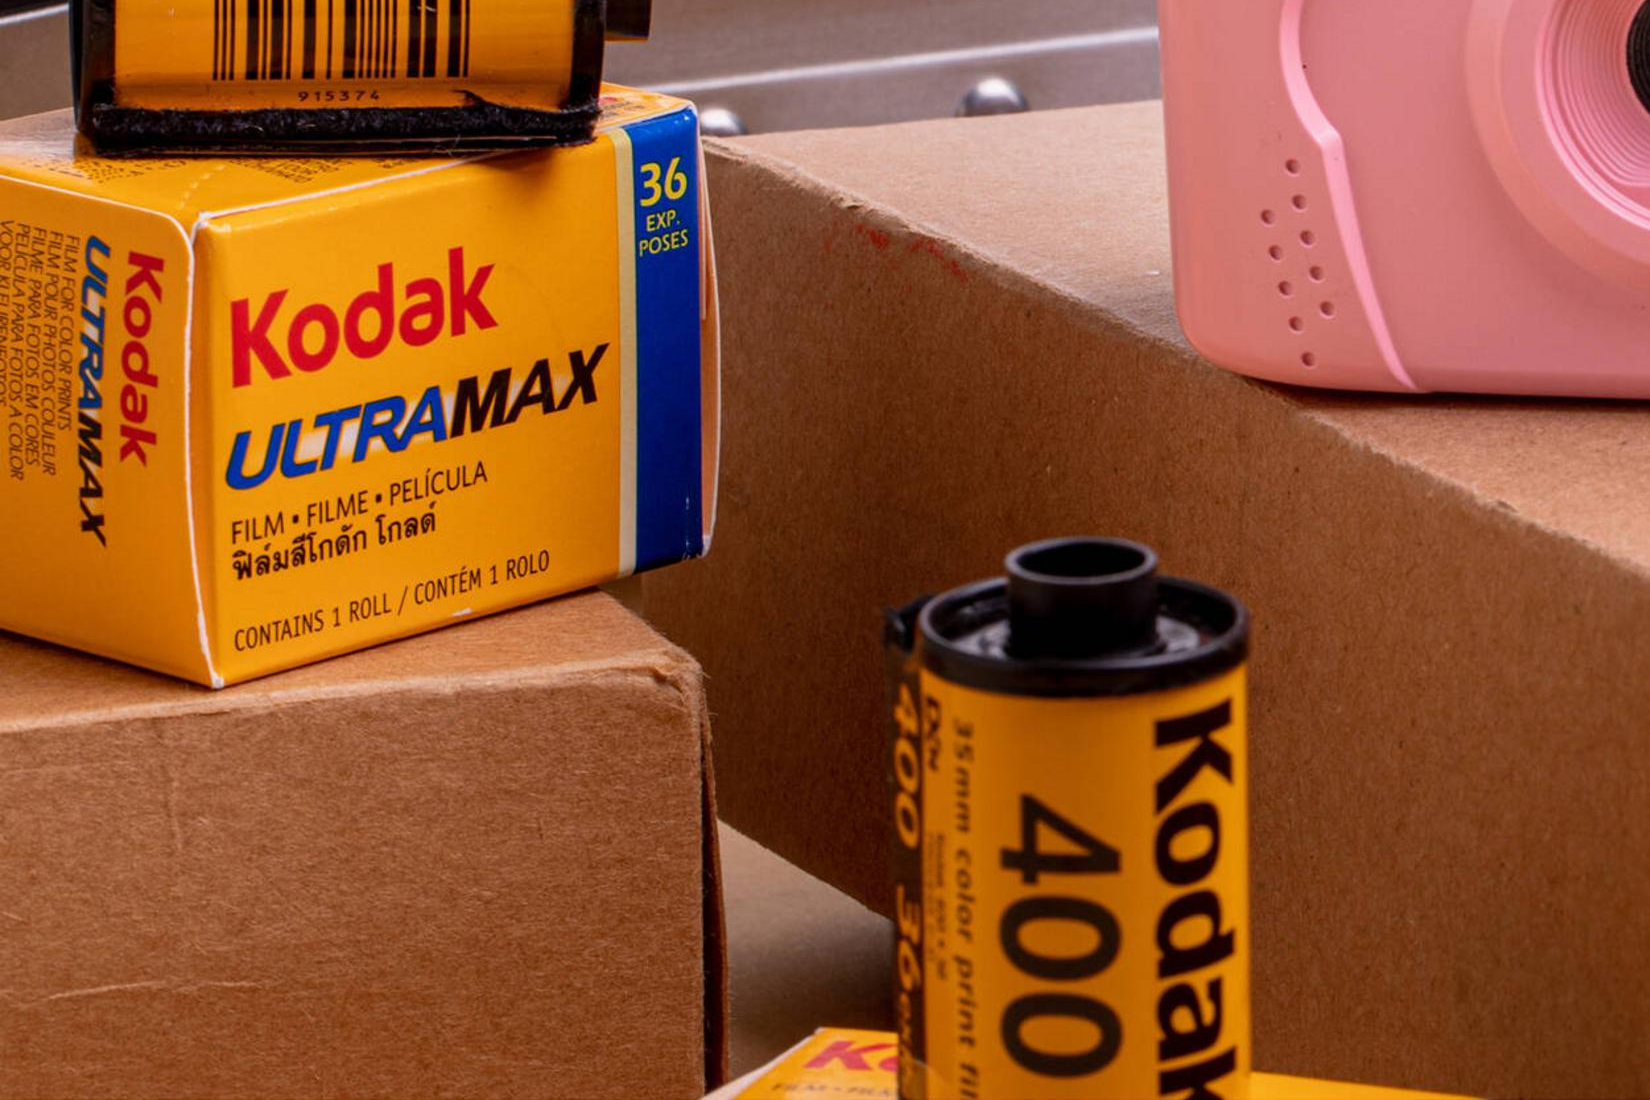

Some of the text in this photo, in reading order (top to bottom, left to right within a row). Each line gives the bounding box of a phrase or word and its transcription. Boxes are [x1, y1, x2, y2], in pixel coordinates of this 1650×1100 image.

[297, 90, 380, 102] 915374
[639, 228, 689, 258] POSES
[640, 156, 687, 207] 36
[646, 209, 681, 232] EXP.
[8, 223, 31, 481] PELÍCULA PARA FOTOS A COLOR
[25, 226, 47, 466] FILME PARA FOTOS EM CORES
[41, 230, 64, 476] FILM POUR PHOTOS COULEUR
[57, 234, 80, 431] FILM FOR COLOR PRINTS
[120, 250, 165, 468] Kodak
[230, 245, 498, 389] Kodak
[78, 235, 111, 548] ULTRAMAX
[225, 342, 610, 490] ULTRAMAX
[231, 460, 488, 544] FILM FILME PELÍCULA
[234, 609, 325, 652] CONTAINS
[332, 606, 342, 627] 1
[349, 592, 392, 624] ROLL
[414, 565, 482, 605] CONTÉM
[489, 564, 499, 586] 1
[506, 549, 550, 581] ROLO
[894, 682, 920, 850] 400
[953, 718, 975, 834] 35mm
[955, 847, 976, 943] color
[1000, 793, 1123, 1079] 400
[1153, 696, 1238, 1100] Kodak
[952, 953, 978, 1048] print
